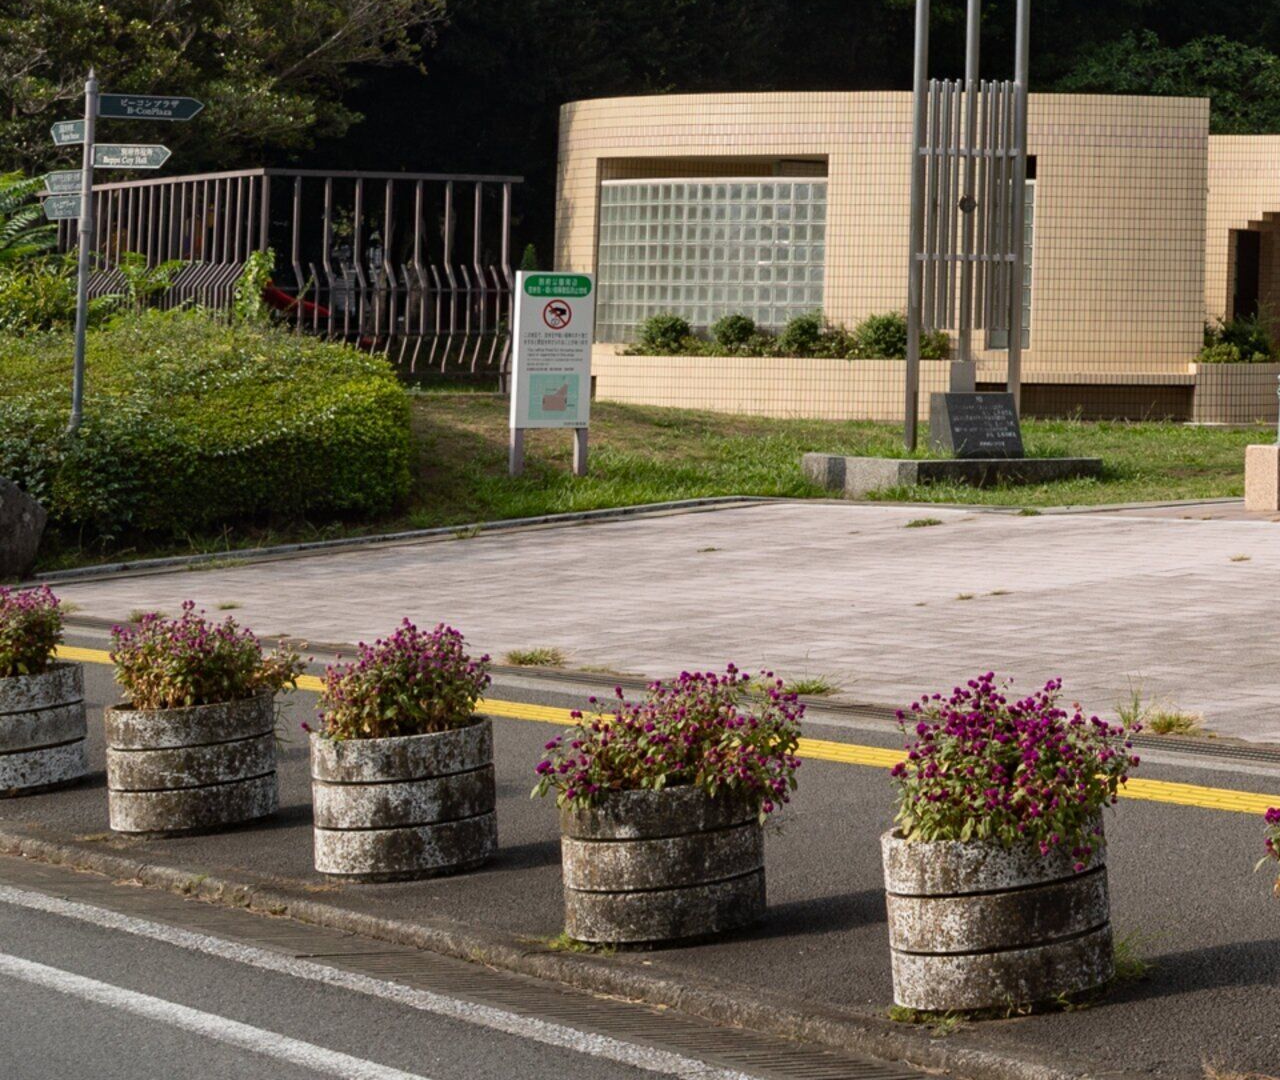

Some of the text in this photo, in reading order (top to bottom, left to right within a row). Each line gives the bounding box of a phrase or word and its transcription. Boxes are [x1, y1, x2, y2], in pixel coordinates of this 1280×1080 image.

[121, 98, 180, 108] ビーコンプラザ
